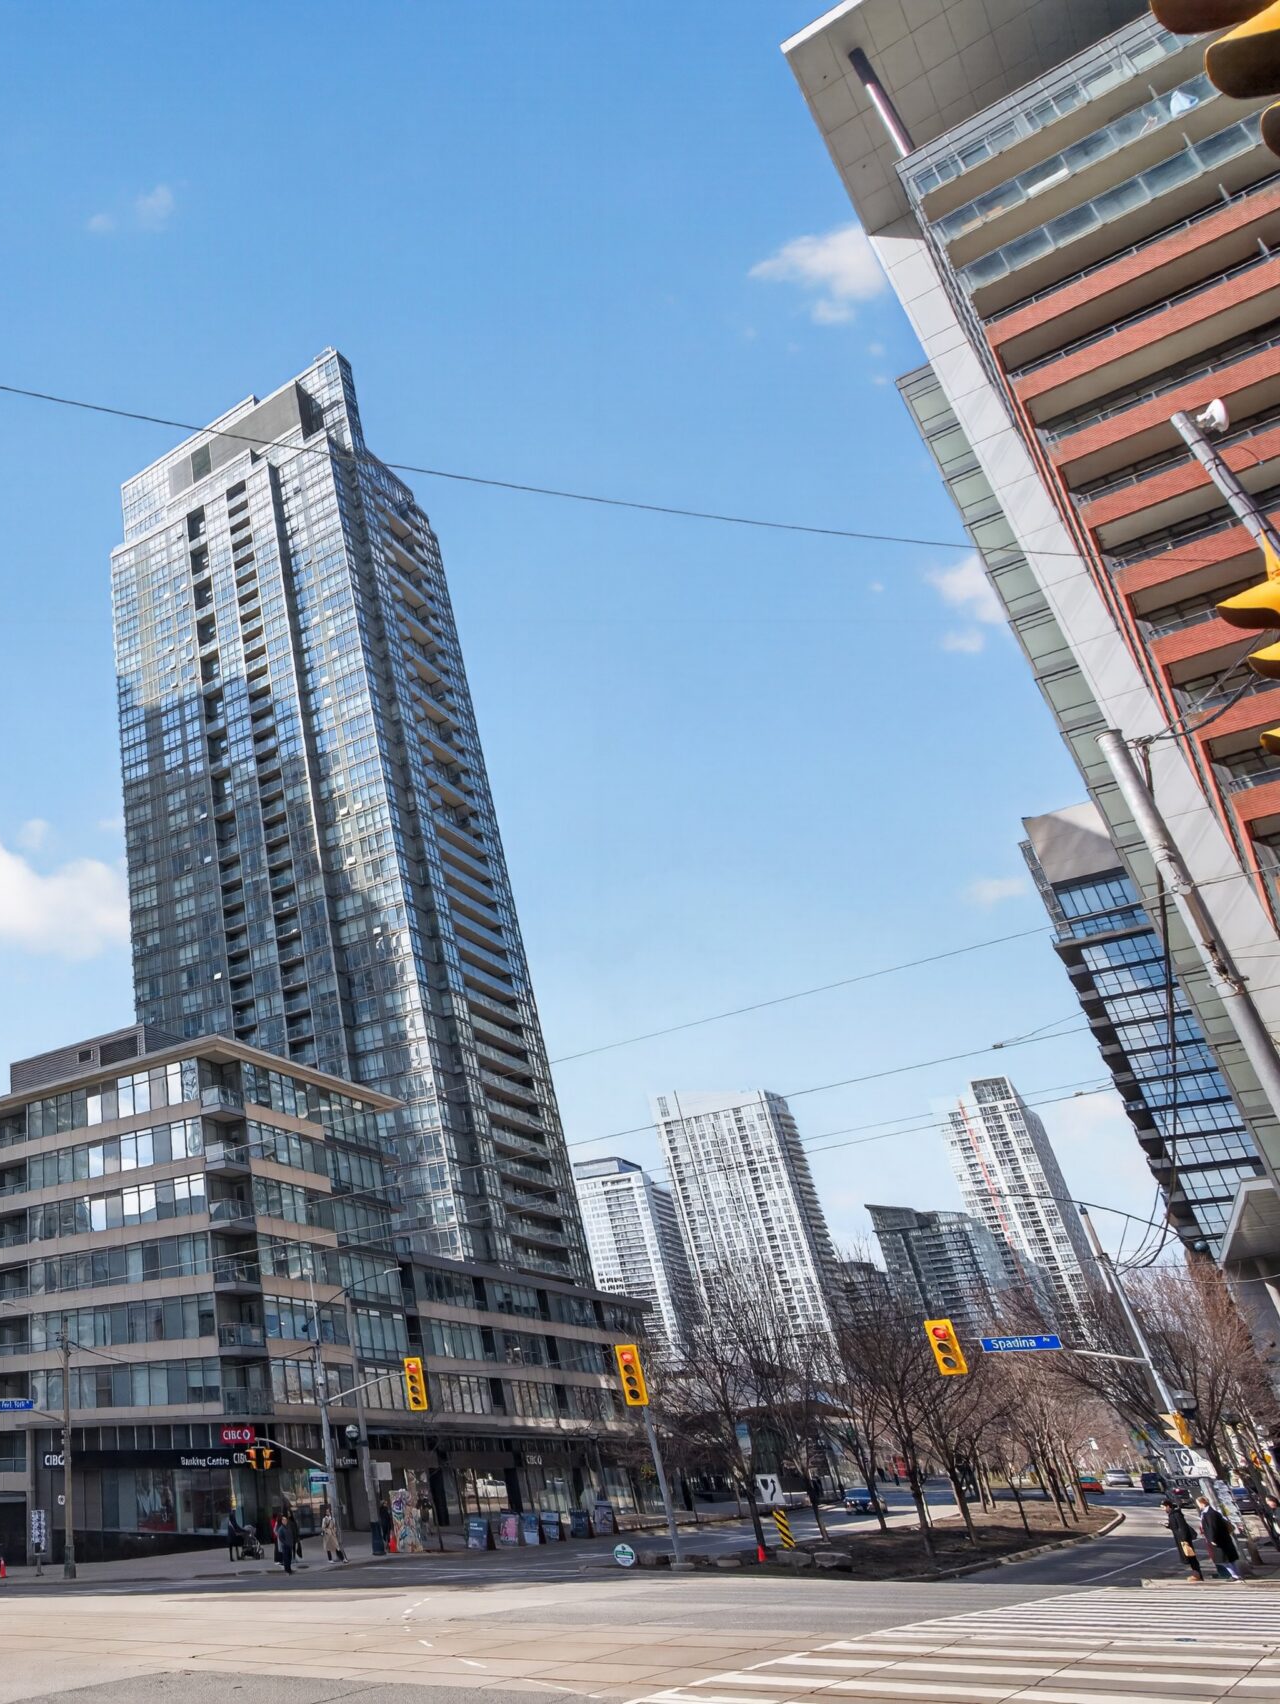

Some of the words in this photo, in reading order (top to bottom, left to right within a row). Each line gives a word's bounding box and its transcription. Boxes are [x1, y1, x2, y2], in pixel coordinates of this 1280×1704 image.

[991, 1338, 1036, 1351] Spadina
[223, 1429, 242, 1440] CIBC
[180, 1456, 206, 1467] Banking
[206, 1456, 230, 1466] Centre
